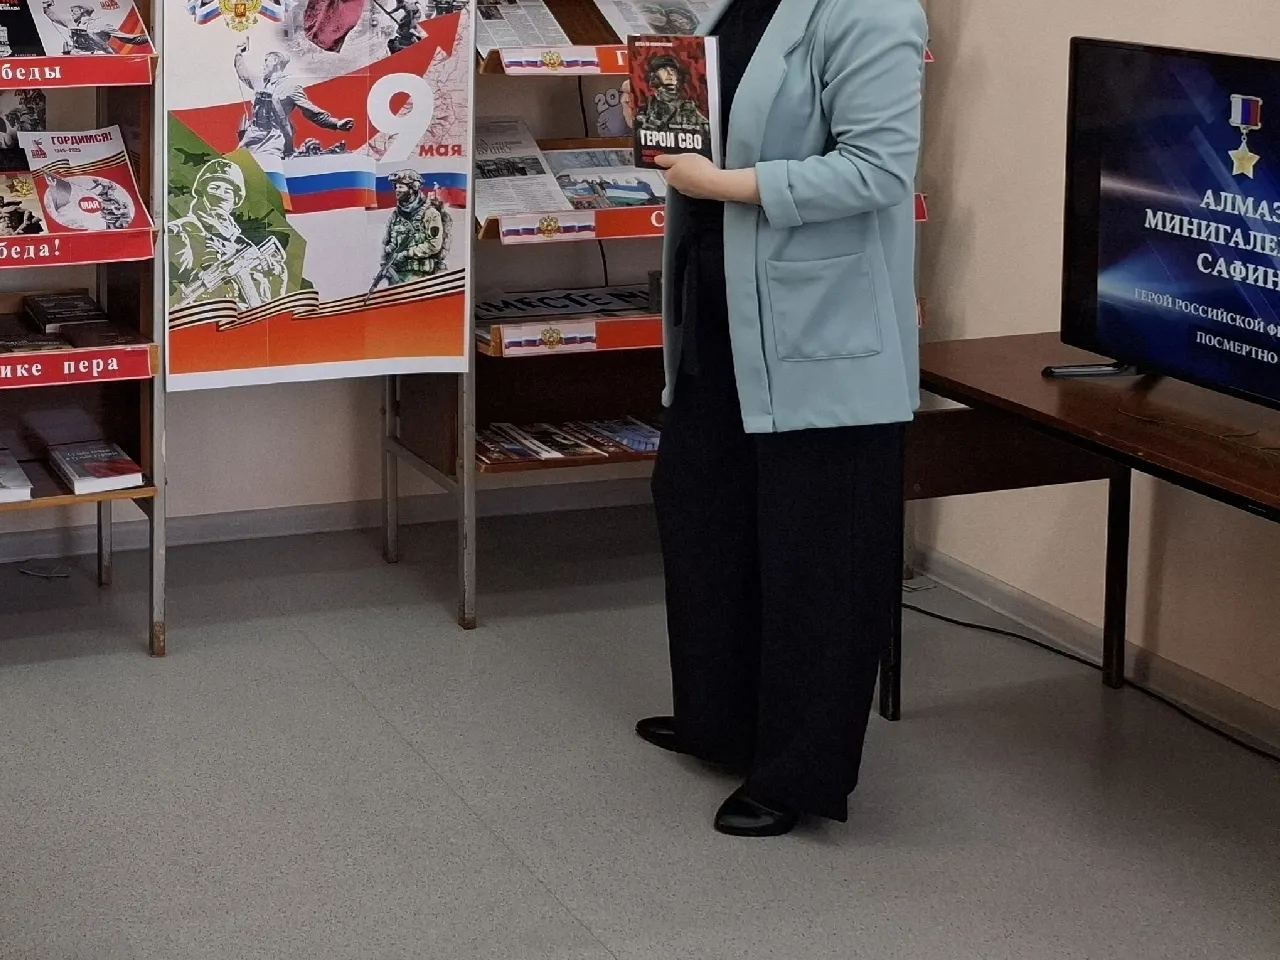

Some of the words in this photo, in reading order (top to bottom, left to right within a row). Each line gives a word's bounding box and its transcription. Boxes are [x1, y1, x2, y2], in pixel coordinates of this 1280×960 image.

[366, 72, 434, 162] 9
[50, 132, 114, 146] ГОРДИМСЯ!
[418, 143, 463, 158] мая
[640, 130, 676, 148] ГЕРОИ
[678, 131, 702, 150] СВО
[80, 200, 100, 210] МАЯ
[1144, 208, 1280, 256] МИНИГАЛЕ
[1134, 287, 1173, 308] ГЕРОЙ
[1174, 297, 1265, 334] РОССИЙСКОЙ
[1195, 331, 1279, 365] ПОСМЕРТНО
[62, 354, 120, 377] пера
